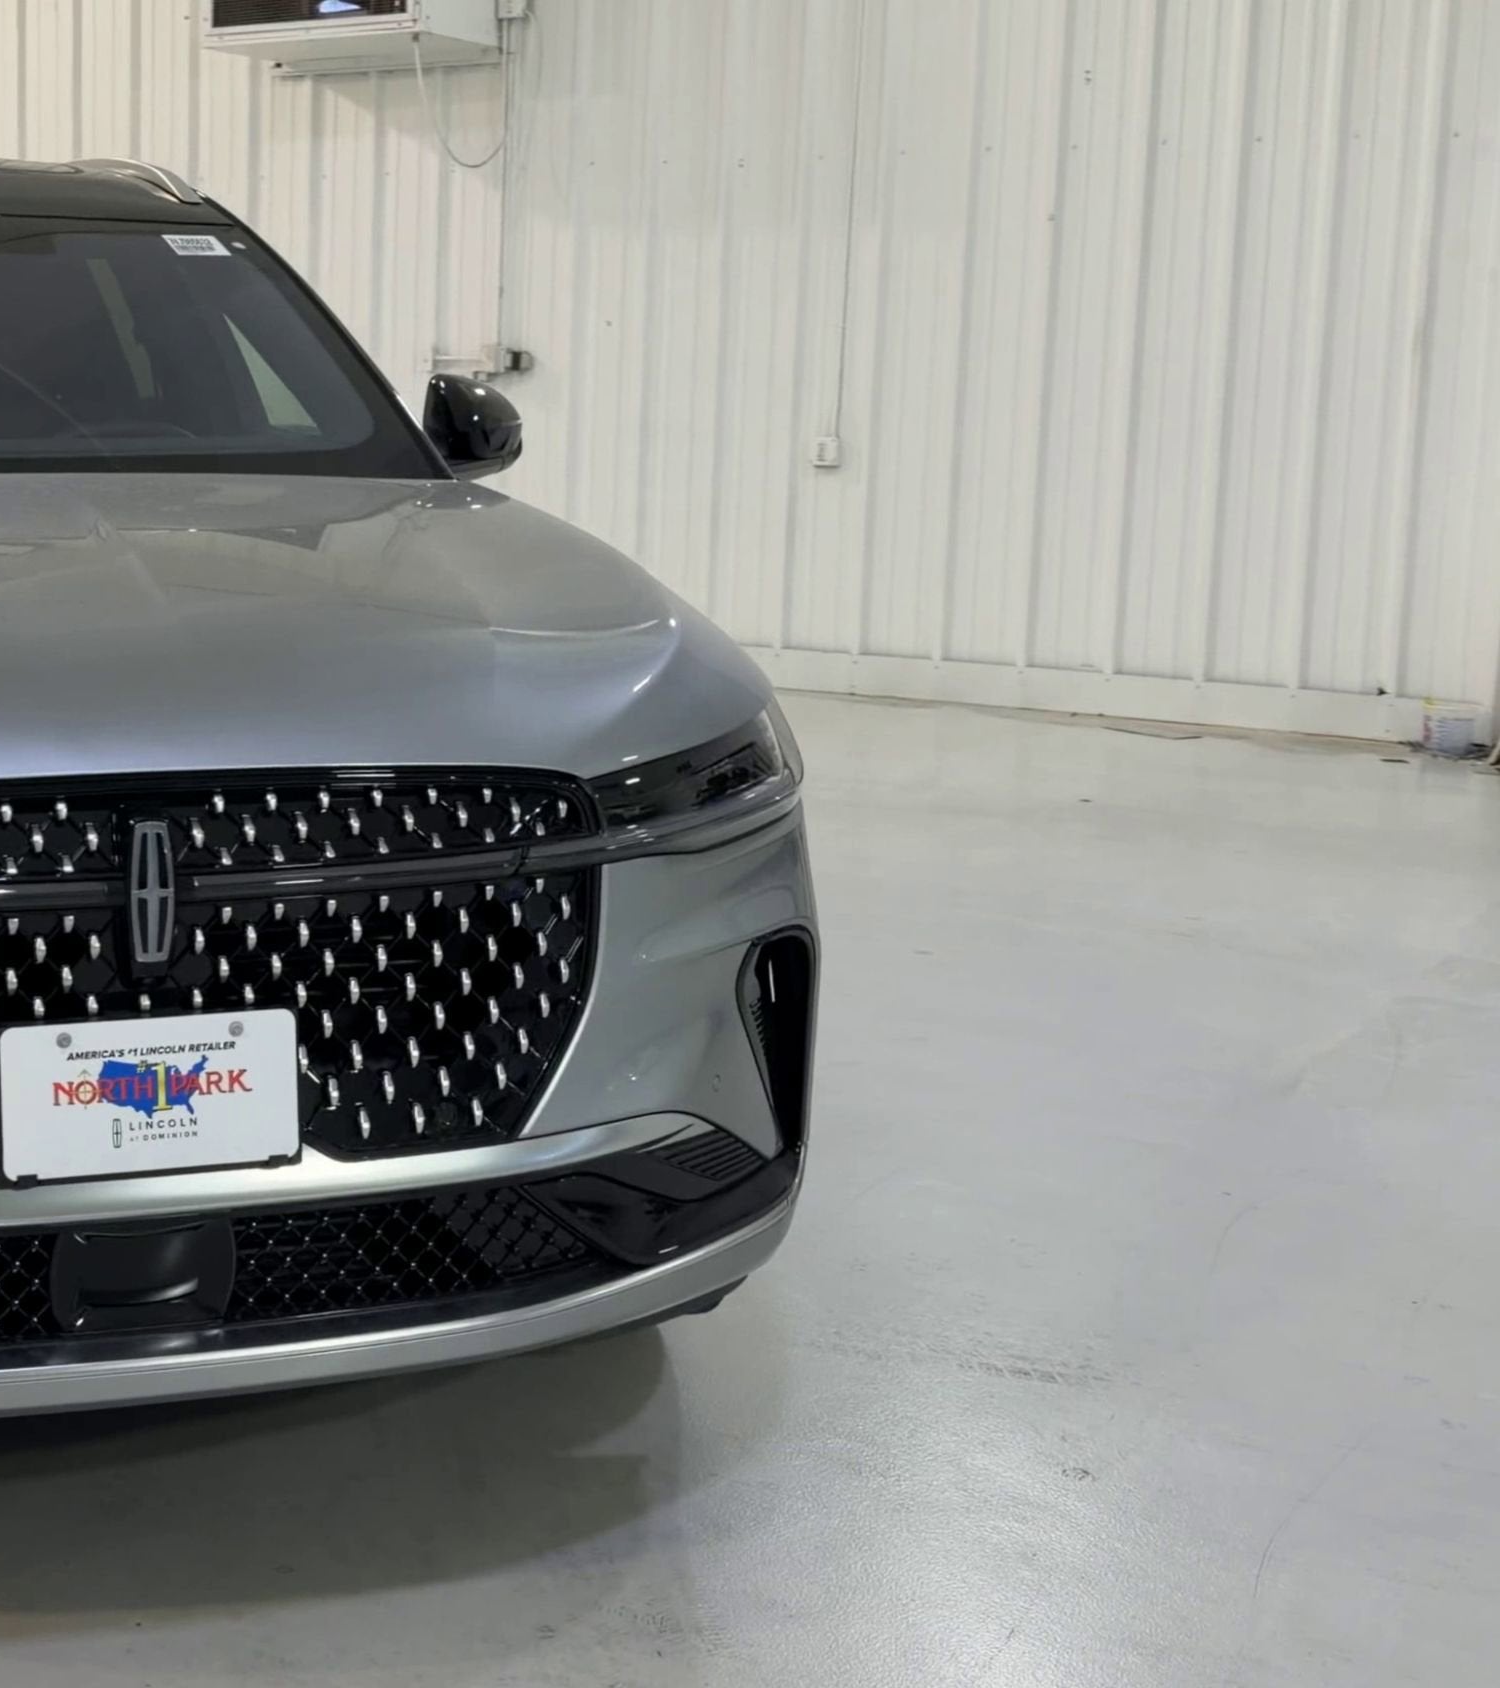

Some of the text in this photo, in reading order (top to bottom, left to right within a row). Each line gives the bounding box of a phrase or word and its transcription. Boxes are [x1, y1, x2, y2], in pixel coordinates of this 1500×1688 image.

[67, 1041, 236, 1061] AMERICA'S #1 LINCOLN RETAILER
[53, 1069, 253, 1106] NORTH PARK
[129, 1117, 198, 1131] LINCOLN
[143, 1131, 198, 1142] DOMINION
